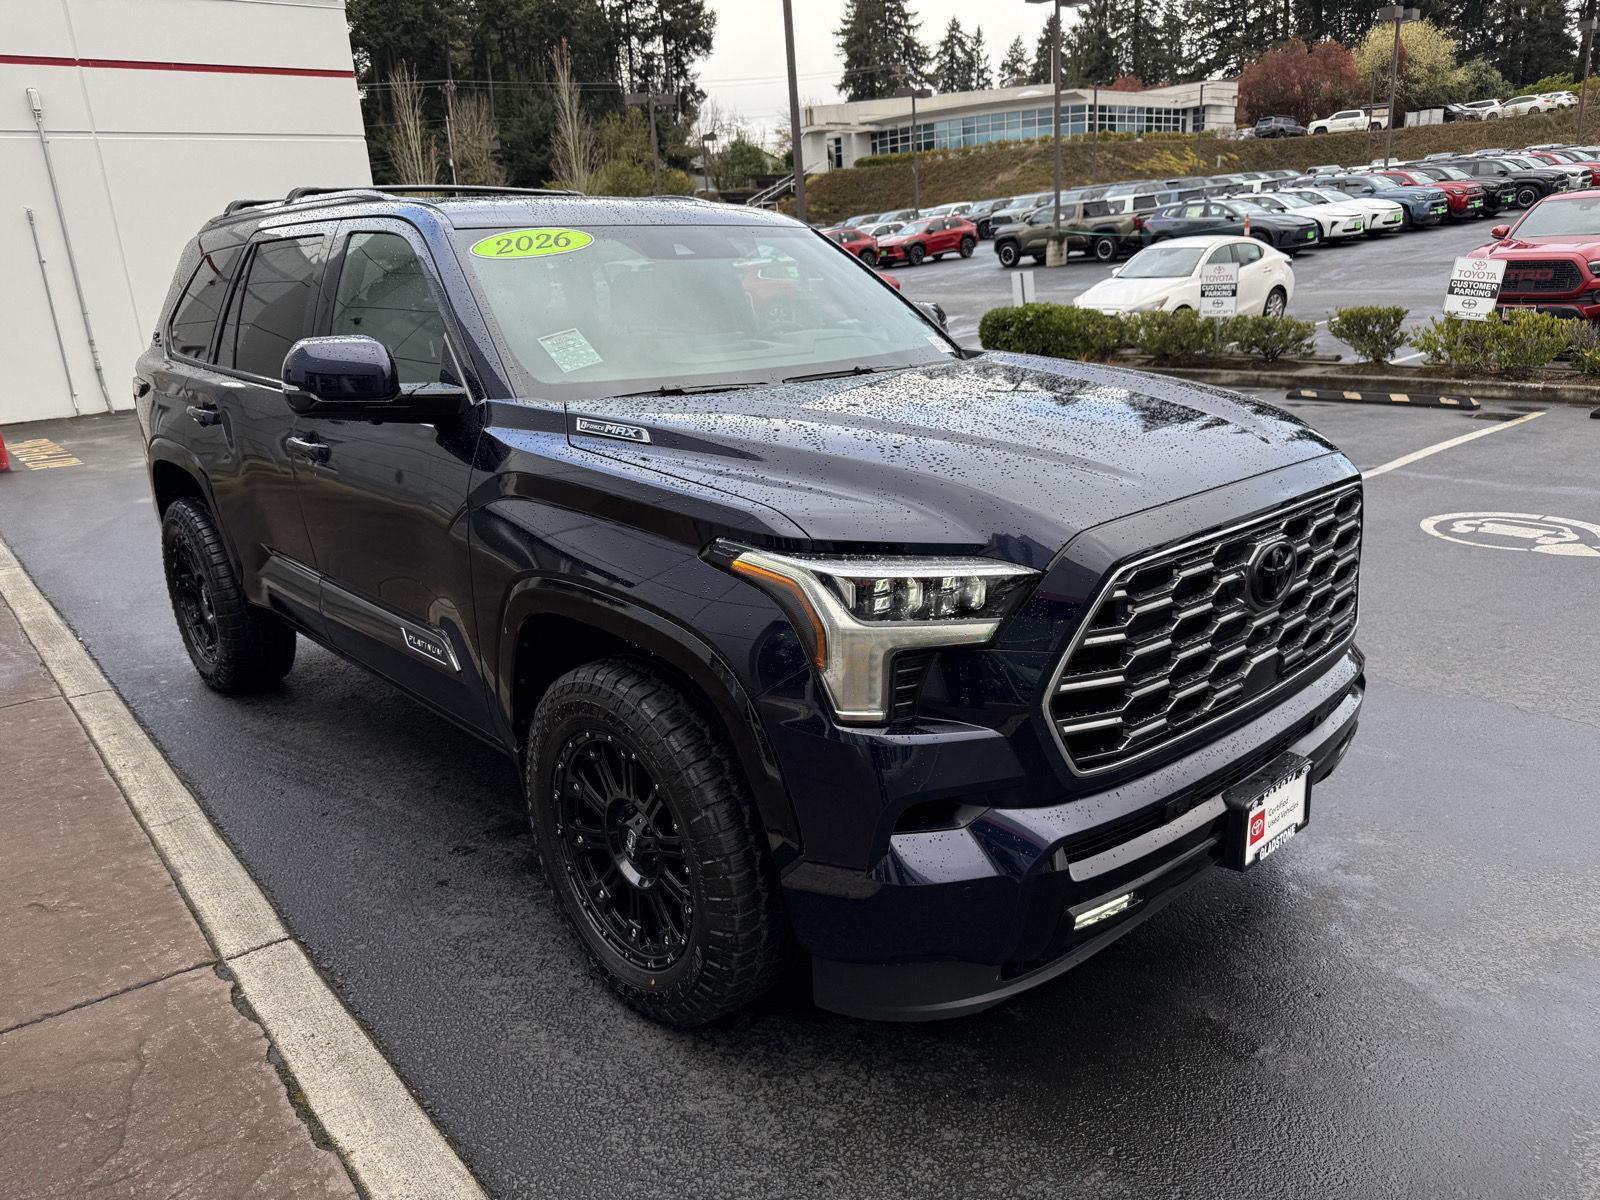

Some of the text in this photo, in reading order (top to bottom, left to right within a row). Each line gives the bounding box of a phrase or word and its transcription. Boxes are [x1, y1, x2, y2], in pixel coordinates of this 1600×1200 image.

[495, 231, 571, 255] 2026
[1205, 274, 1234, 282] TOYOTA
[1458, 269, 1497, 280] TOYOTA
[1451, 280, 1498, 291] CUSTOMER
[1453, 287, 1491, 298] PARKING
[408, 634, 443, 657] PLATINUM
[1268, 796, 1289, 816] Certified
[1268, 800, 1299, 829] Used Vehicles
[1260, 823, 1296, 861] GLADSTONE
